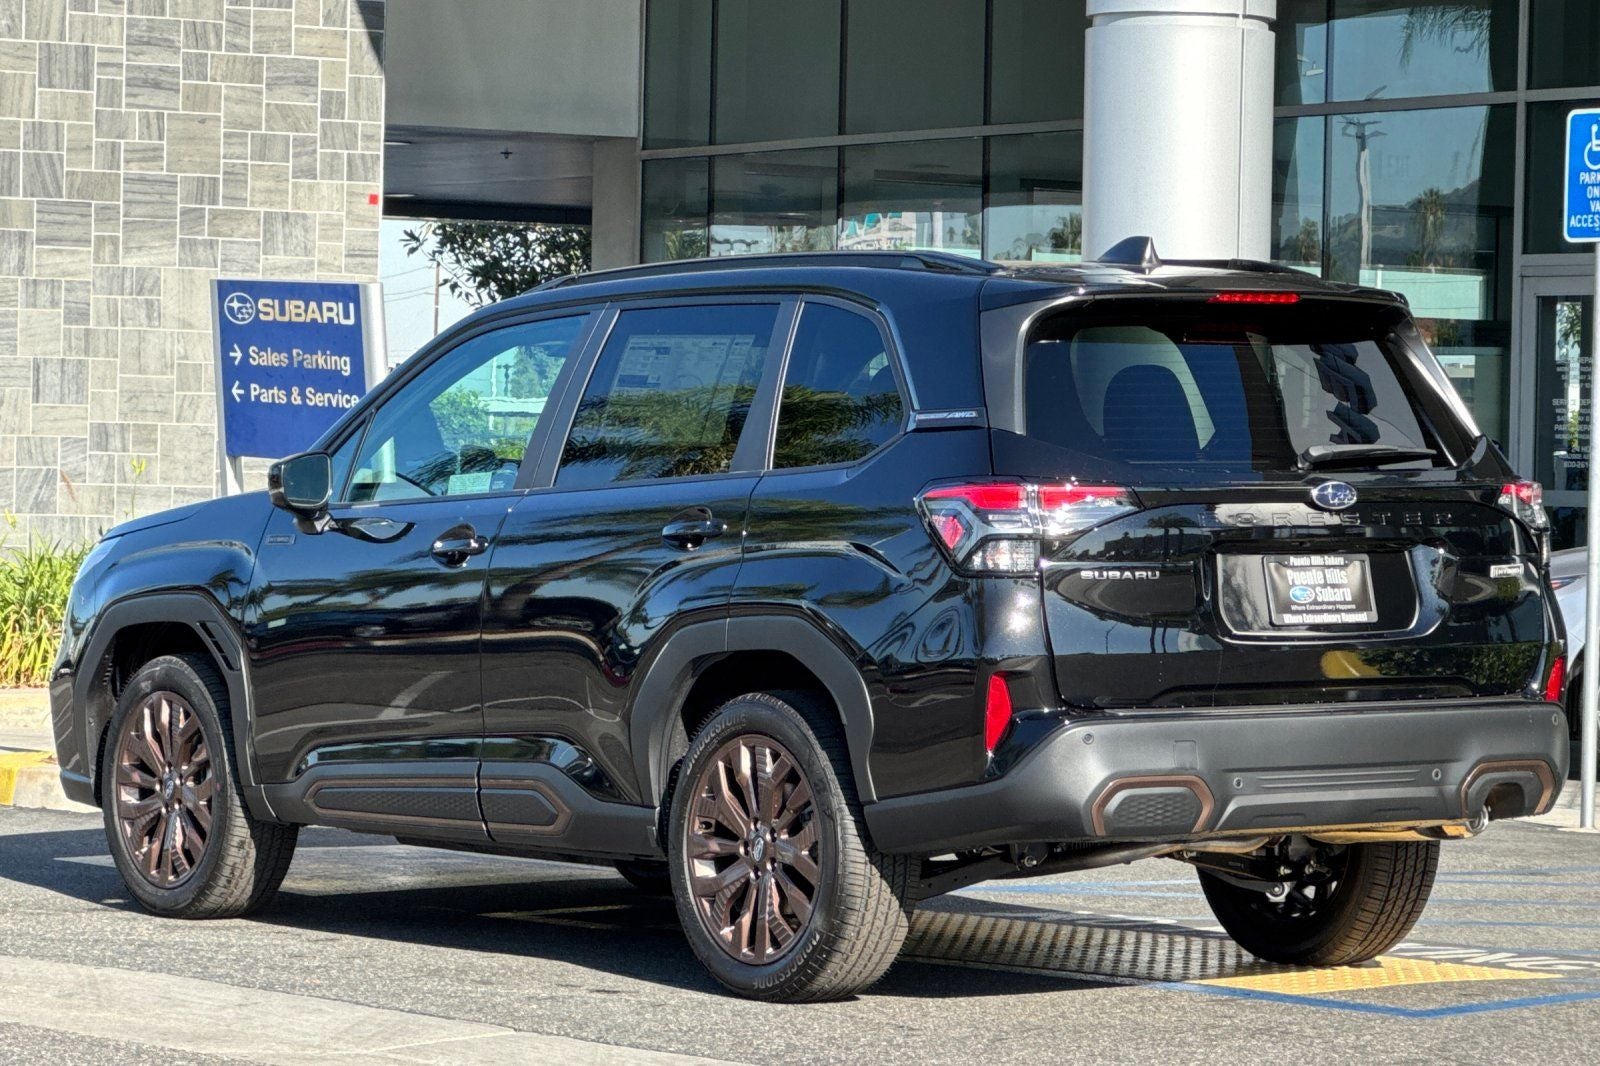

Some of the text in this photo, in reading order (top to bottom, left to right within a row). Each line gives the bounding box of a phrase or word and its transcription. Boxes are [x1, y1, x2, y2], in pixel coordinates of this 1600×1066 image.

[1570, 214, 1600, 228] ACCES
[257, 298, 355, 325] SUBARU
[249, 346, 351, 376] Sales Parking
[250, 383, 360, 409] Parts & Service
[1081, 570, 1160, 580] SUBARU
[1286, 568, 1349, 586] Puente Hills
[1315, 586, 1352, 602] Subaru
